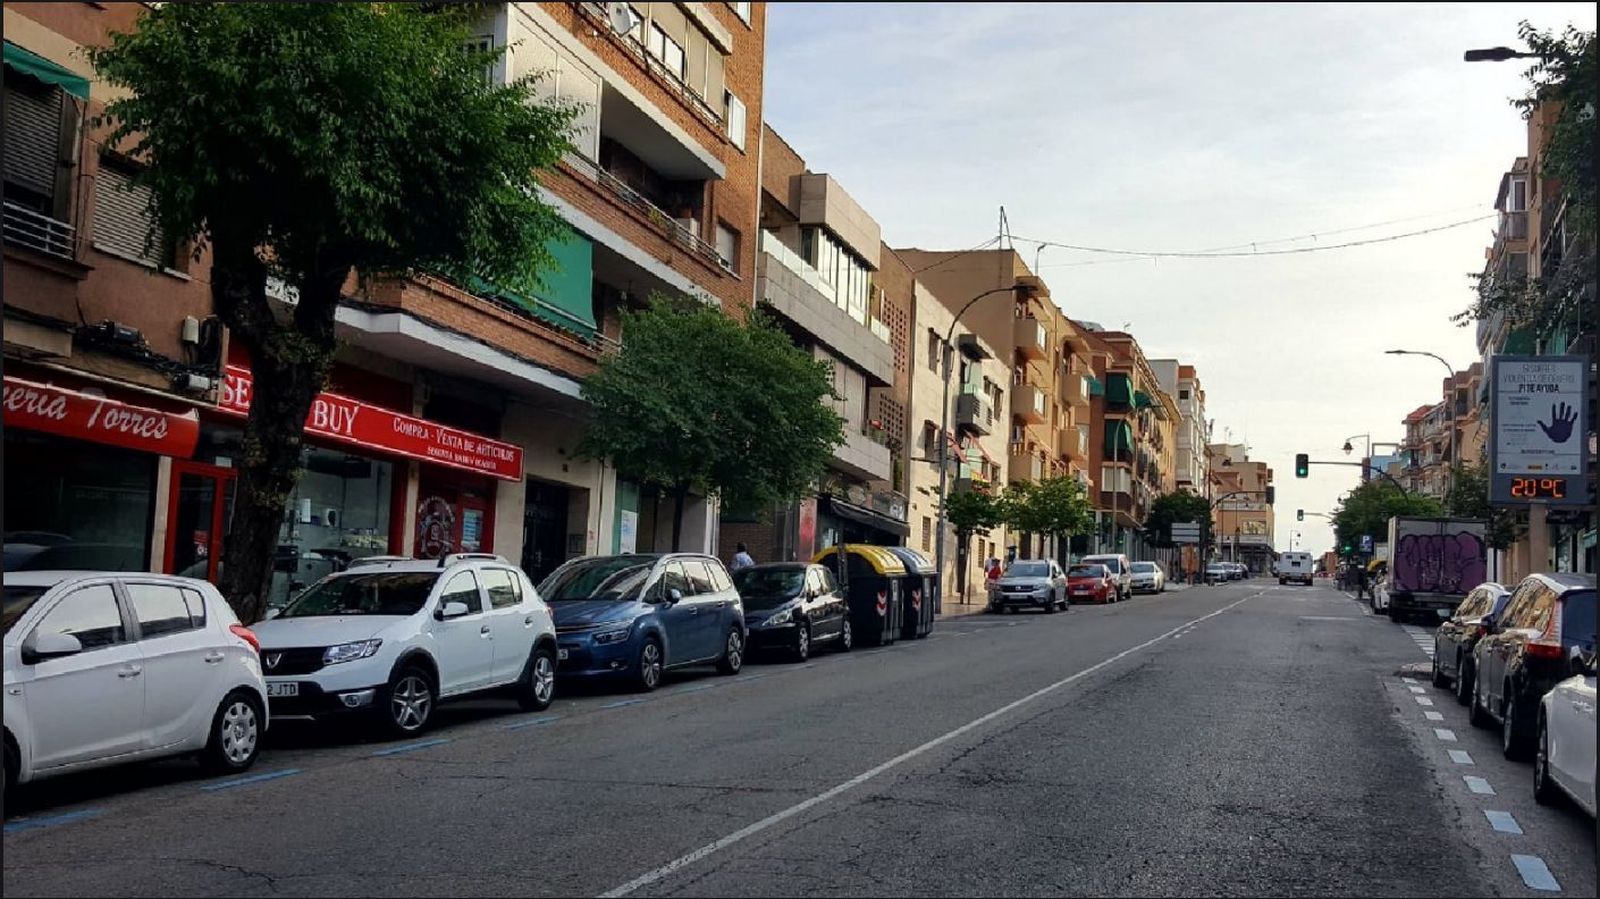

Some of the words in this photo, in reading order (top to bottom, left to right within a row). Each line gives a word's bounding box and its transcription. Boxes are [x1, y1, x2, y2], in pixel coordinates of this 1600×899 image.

[80, 387, 168, 439] Torres
[313, 400, 359, 436] BUY
[436, 428, 463, 450] VENTA
[274, 684, 296, 696] JTD
